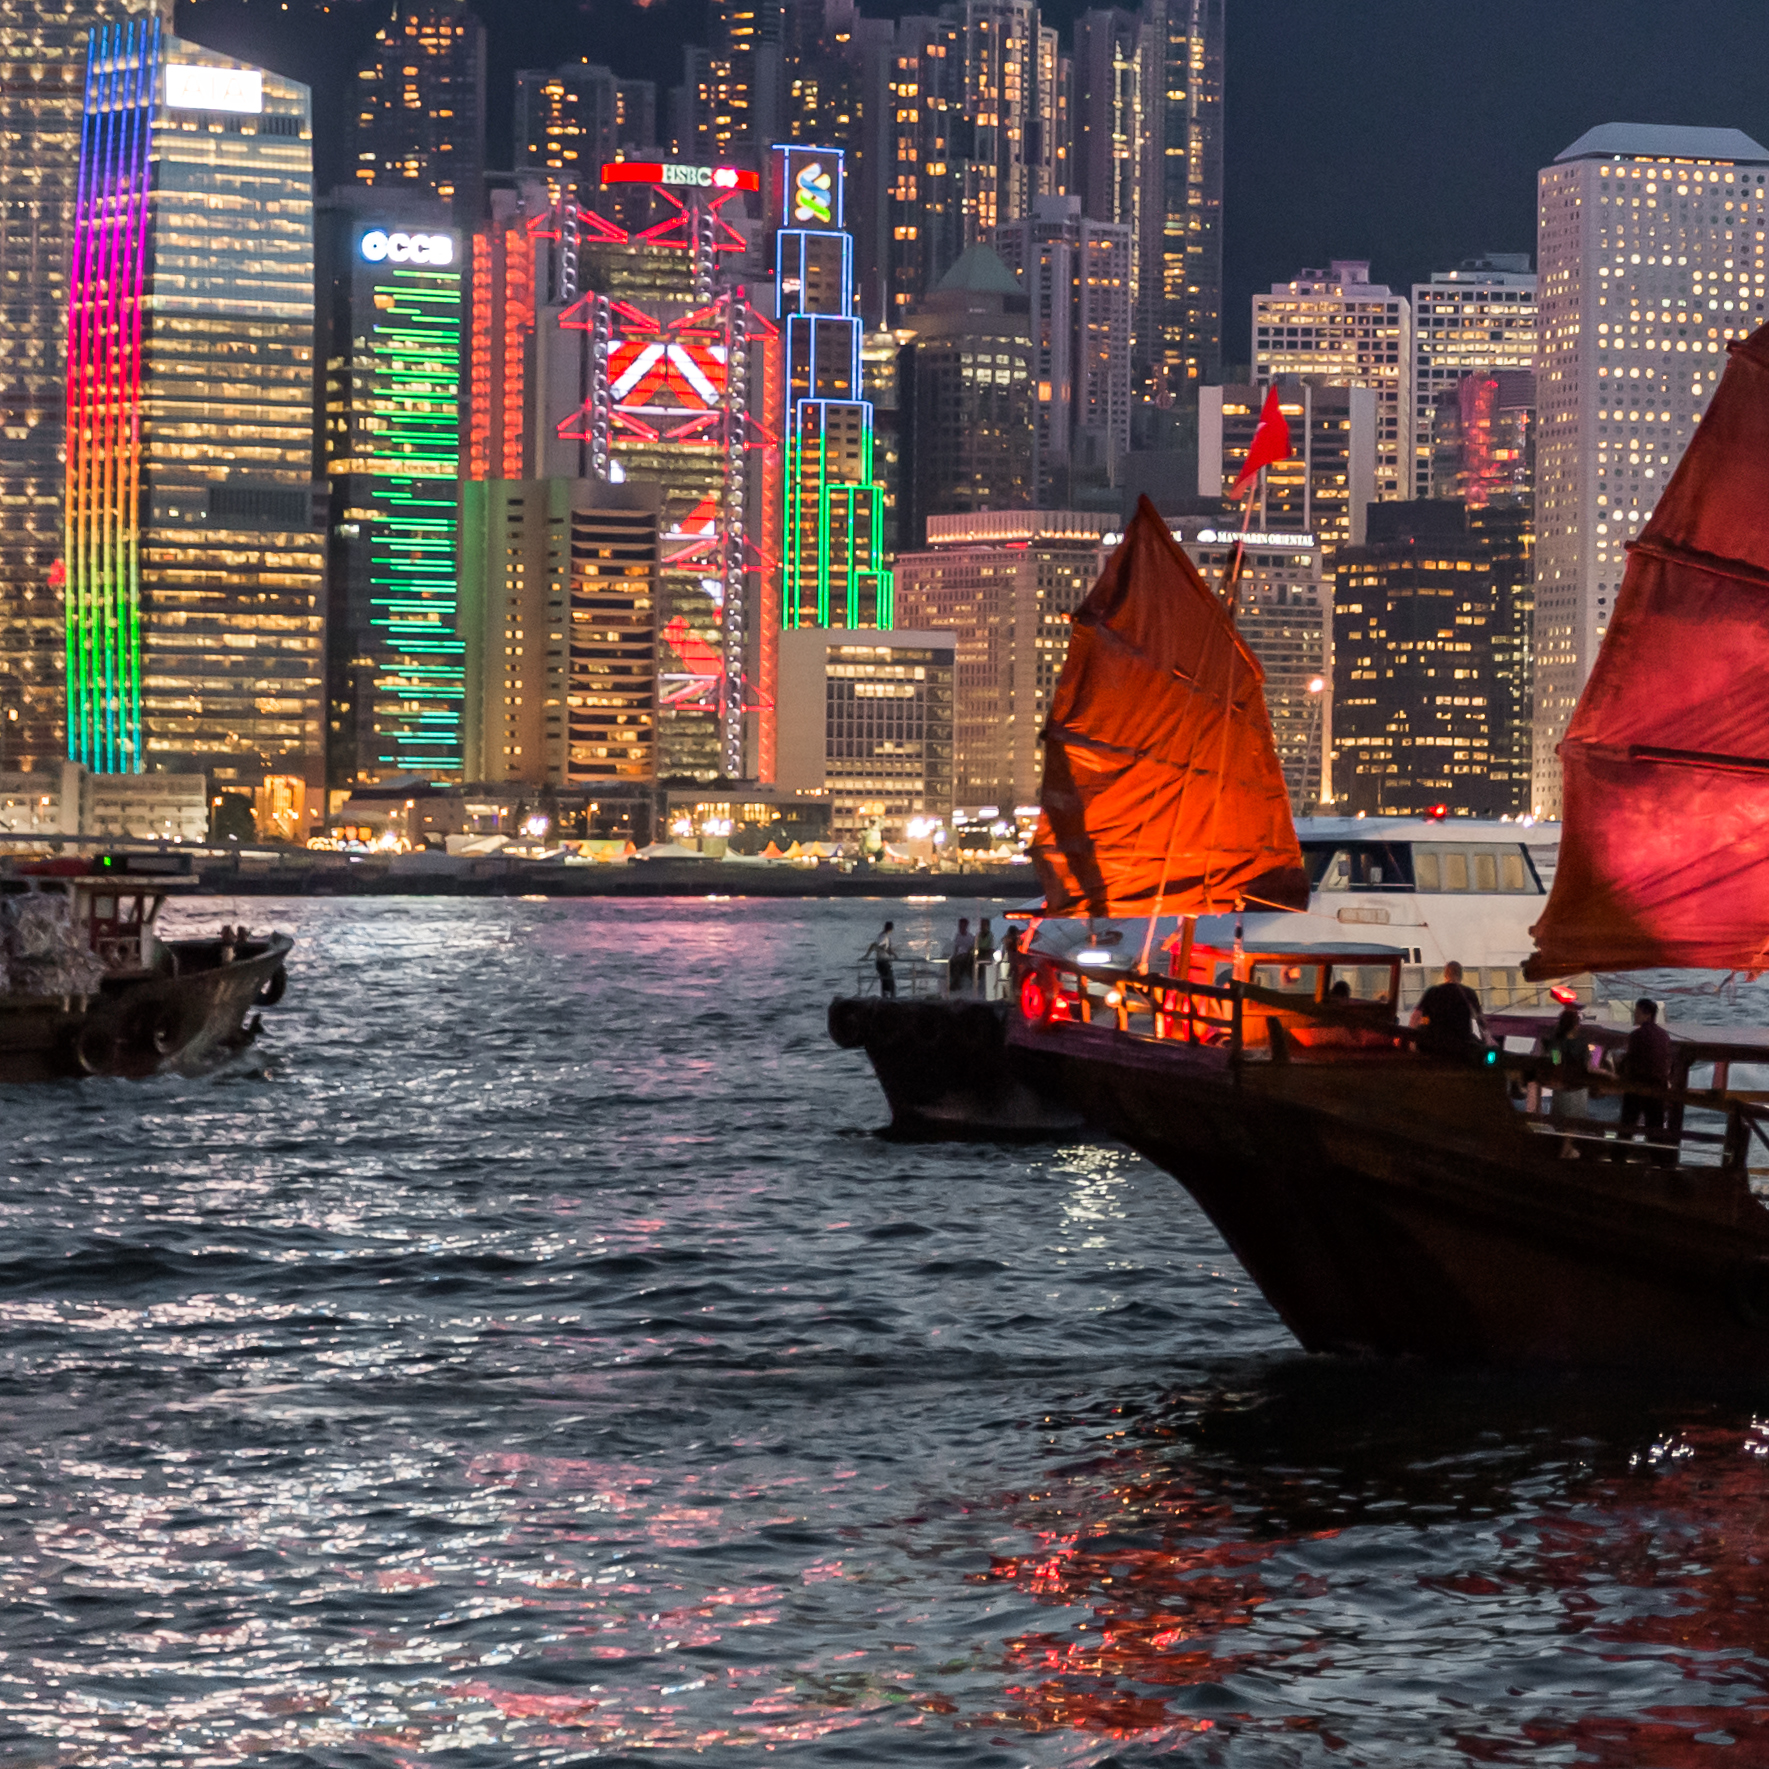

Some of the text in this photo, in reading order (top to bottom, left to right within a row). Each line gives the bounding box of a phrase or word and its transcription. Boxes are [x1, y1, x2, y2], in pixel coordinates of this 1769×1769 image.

[180, 74, 247, 104] AIA
[662, 163, 713, 187] HSBC
[1217, 530, 1315, 548] MANDARIN ORIENTAL
